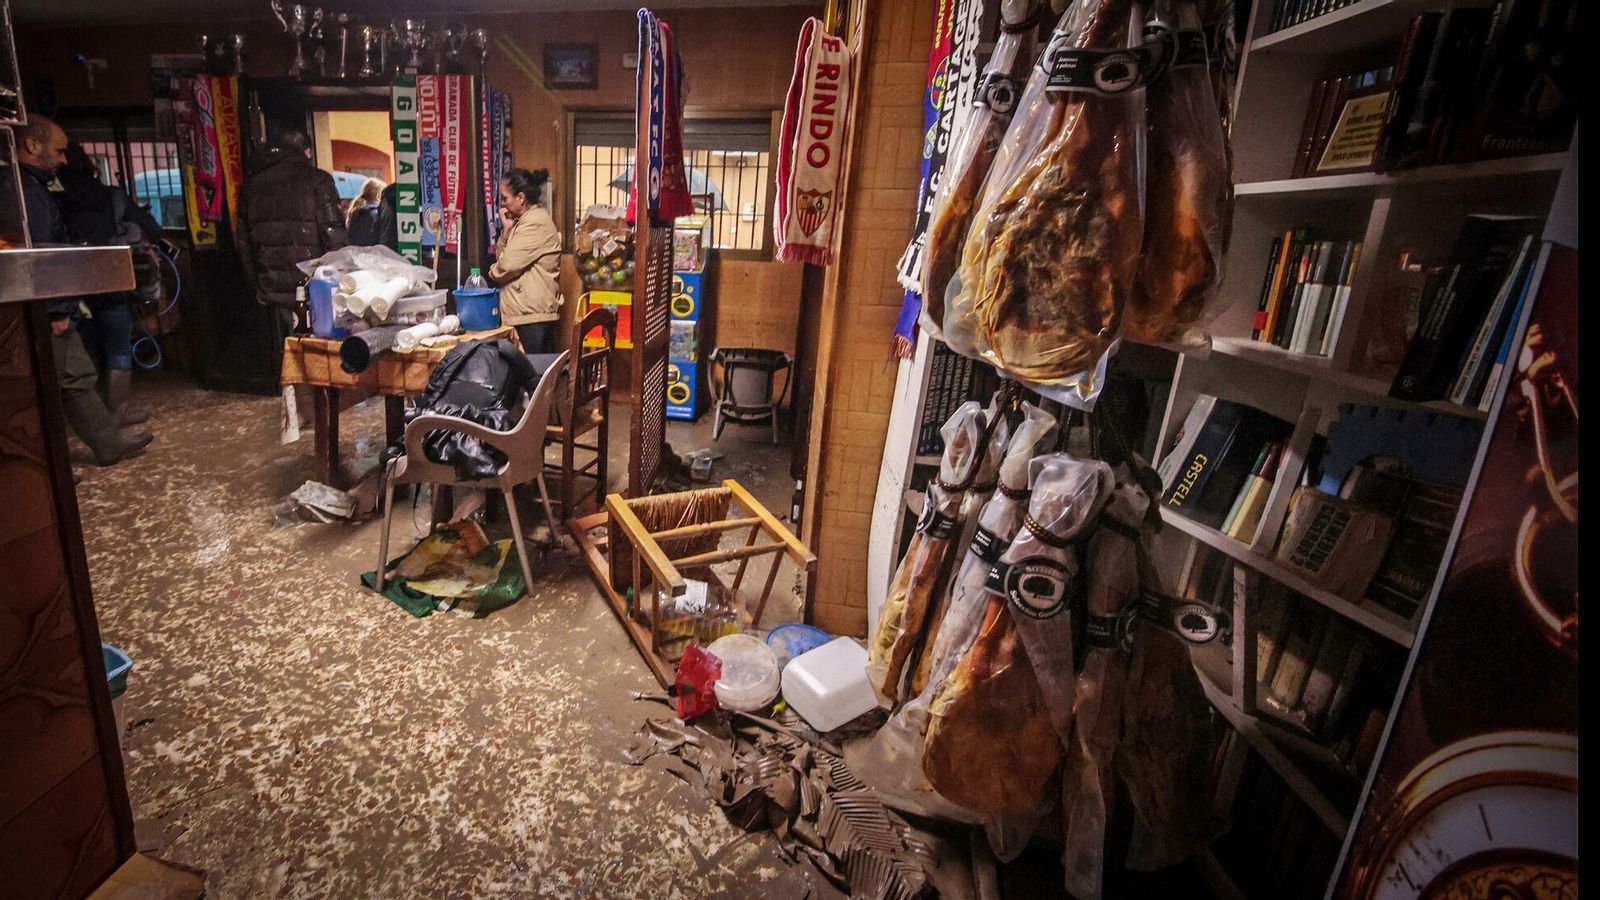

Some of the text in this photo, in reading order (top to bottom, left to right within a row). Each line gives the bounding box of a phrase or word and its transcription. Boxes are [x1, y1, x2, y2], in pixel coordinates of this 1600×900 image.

[419, 75, 437, 133] LUTON
[806, 63, 841, 169] RINDO
[937, 0, 968, 153] CARTAGE
[396, 96, 418, 261] GDANSK
[423, 139, 435, 204] MANCHESTER
[447, 75, 459, 205] GRANADA CLUB DE FÚTBOL
[650, 126, 659, 157] FC
